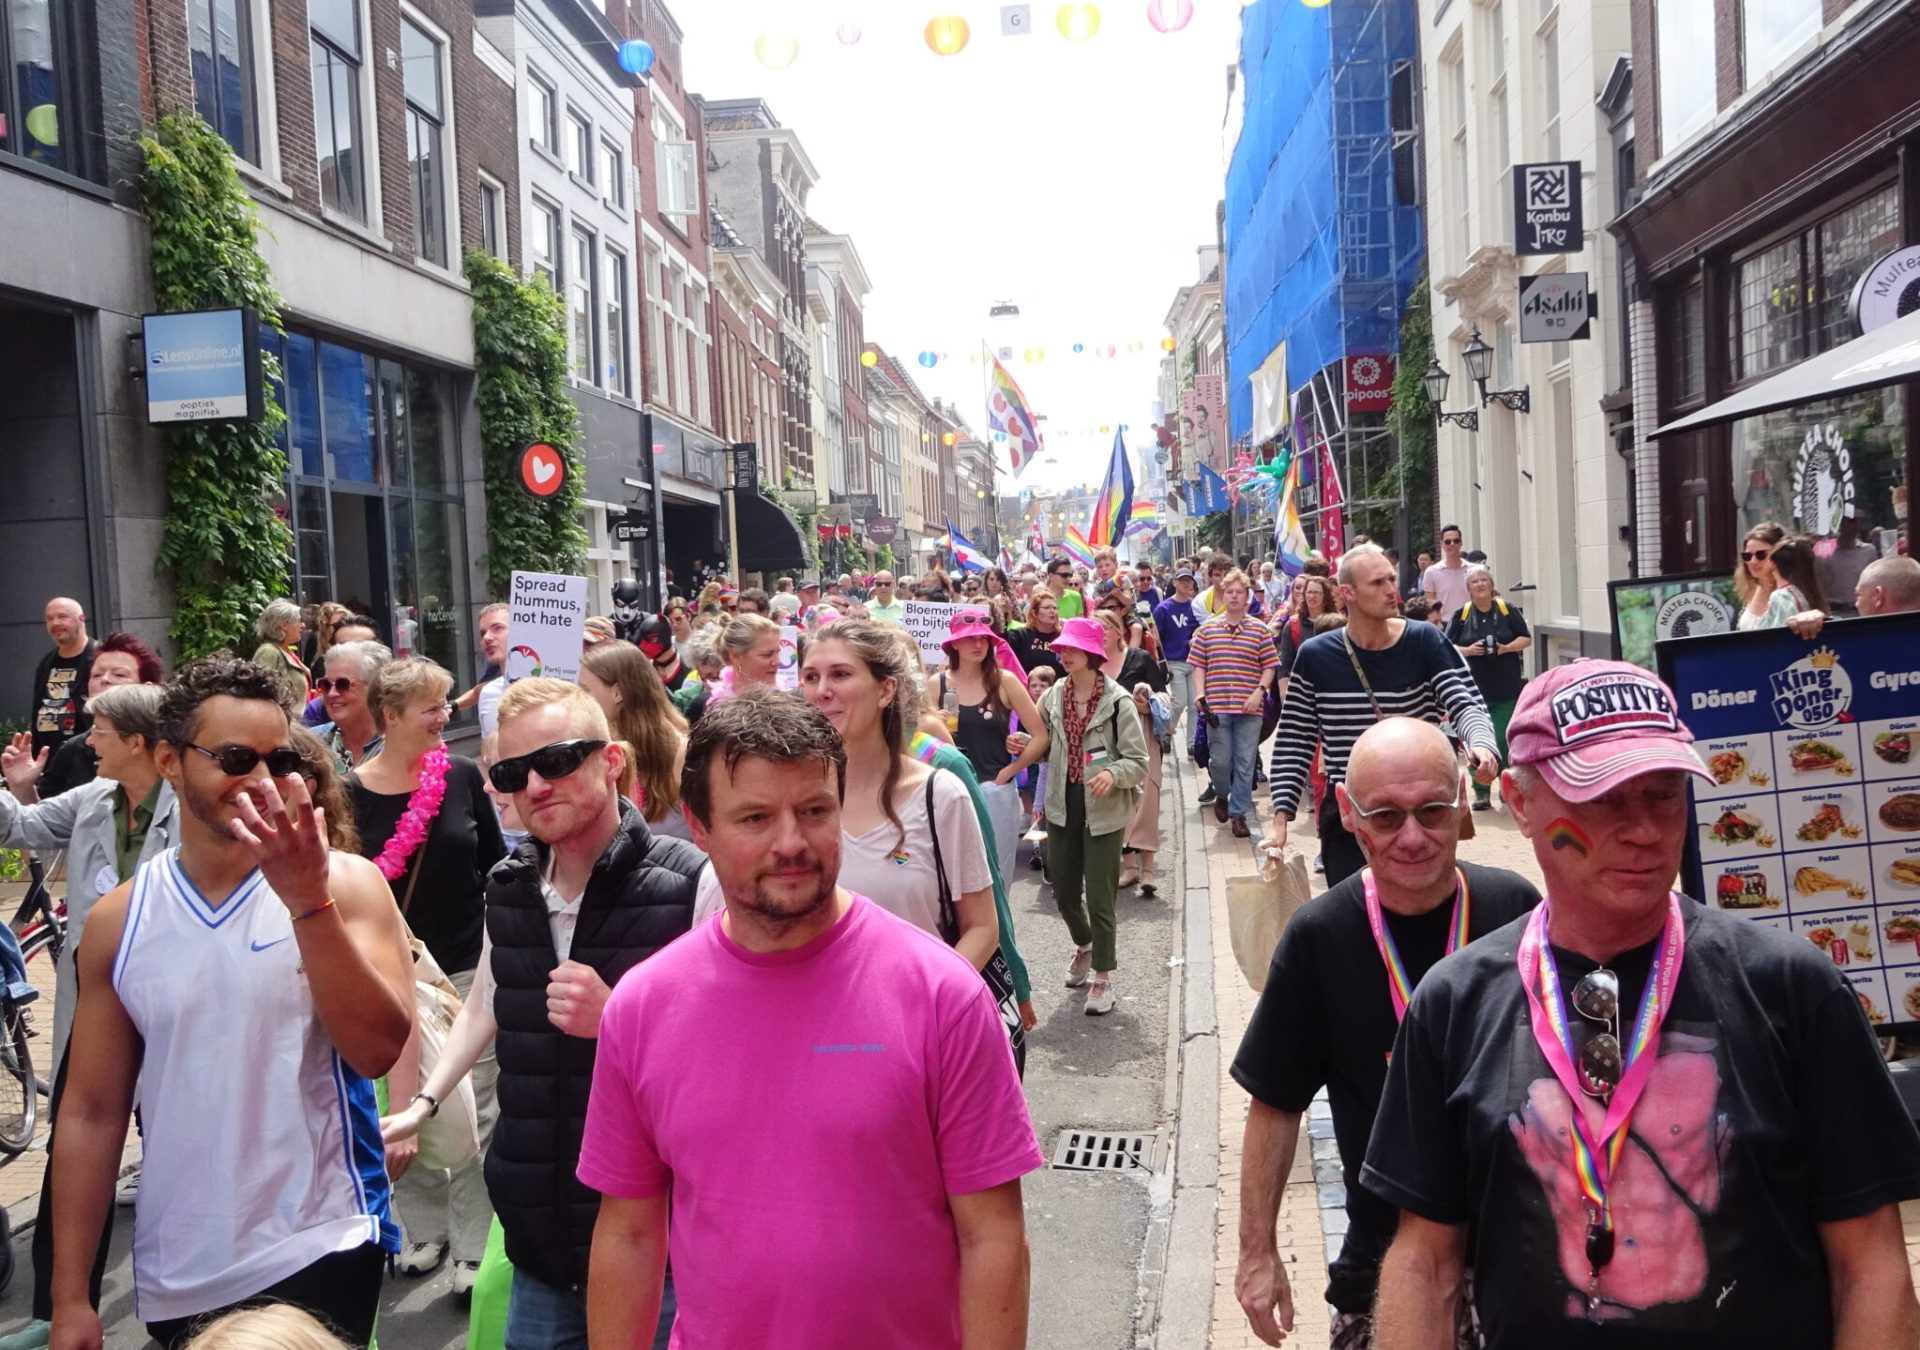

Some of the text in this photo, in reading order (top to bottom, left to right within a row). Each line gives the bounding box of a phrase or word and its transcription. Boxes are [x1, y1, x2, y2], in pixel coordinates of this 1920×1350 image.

[1011, 14, 1021, 26] G
[1526, 208, 1570, 224] Konbu
[1524, 289, 1583, 316] Asahi
[1347, 388, 1388, 403] pipoos
[174, 408, 222, 420] magnifiek
[1793, 423, 1822, 518] MULTEA
[515, 575, 567, 592] Spread
[514, 592, 580, 613] hummus,
[1660, 597, 1725, 626] MULTEA CHOICE
[513, 611, 572, 627] not hate
[905, 617, 919, 626] en
[909, 630, 931, 638] oor
[544, 665, 561, 675] Partij
[1770, 668, 1833, 697] King
[1555, 683, 1671, 727] POSITIVE
[1691, 689, 1757, 710] Döner
[1771, 686, 1843, 723] Döner
[1802, 702, 1834, 722] 050
